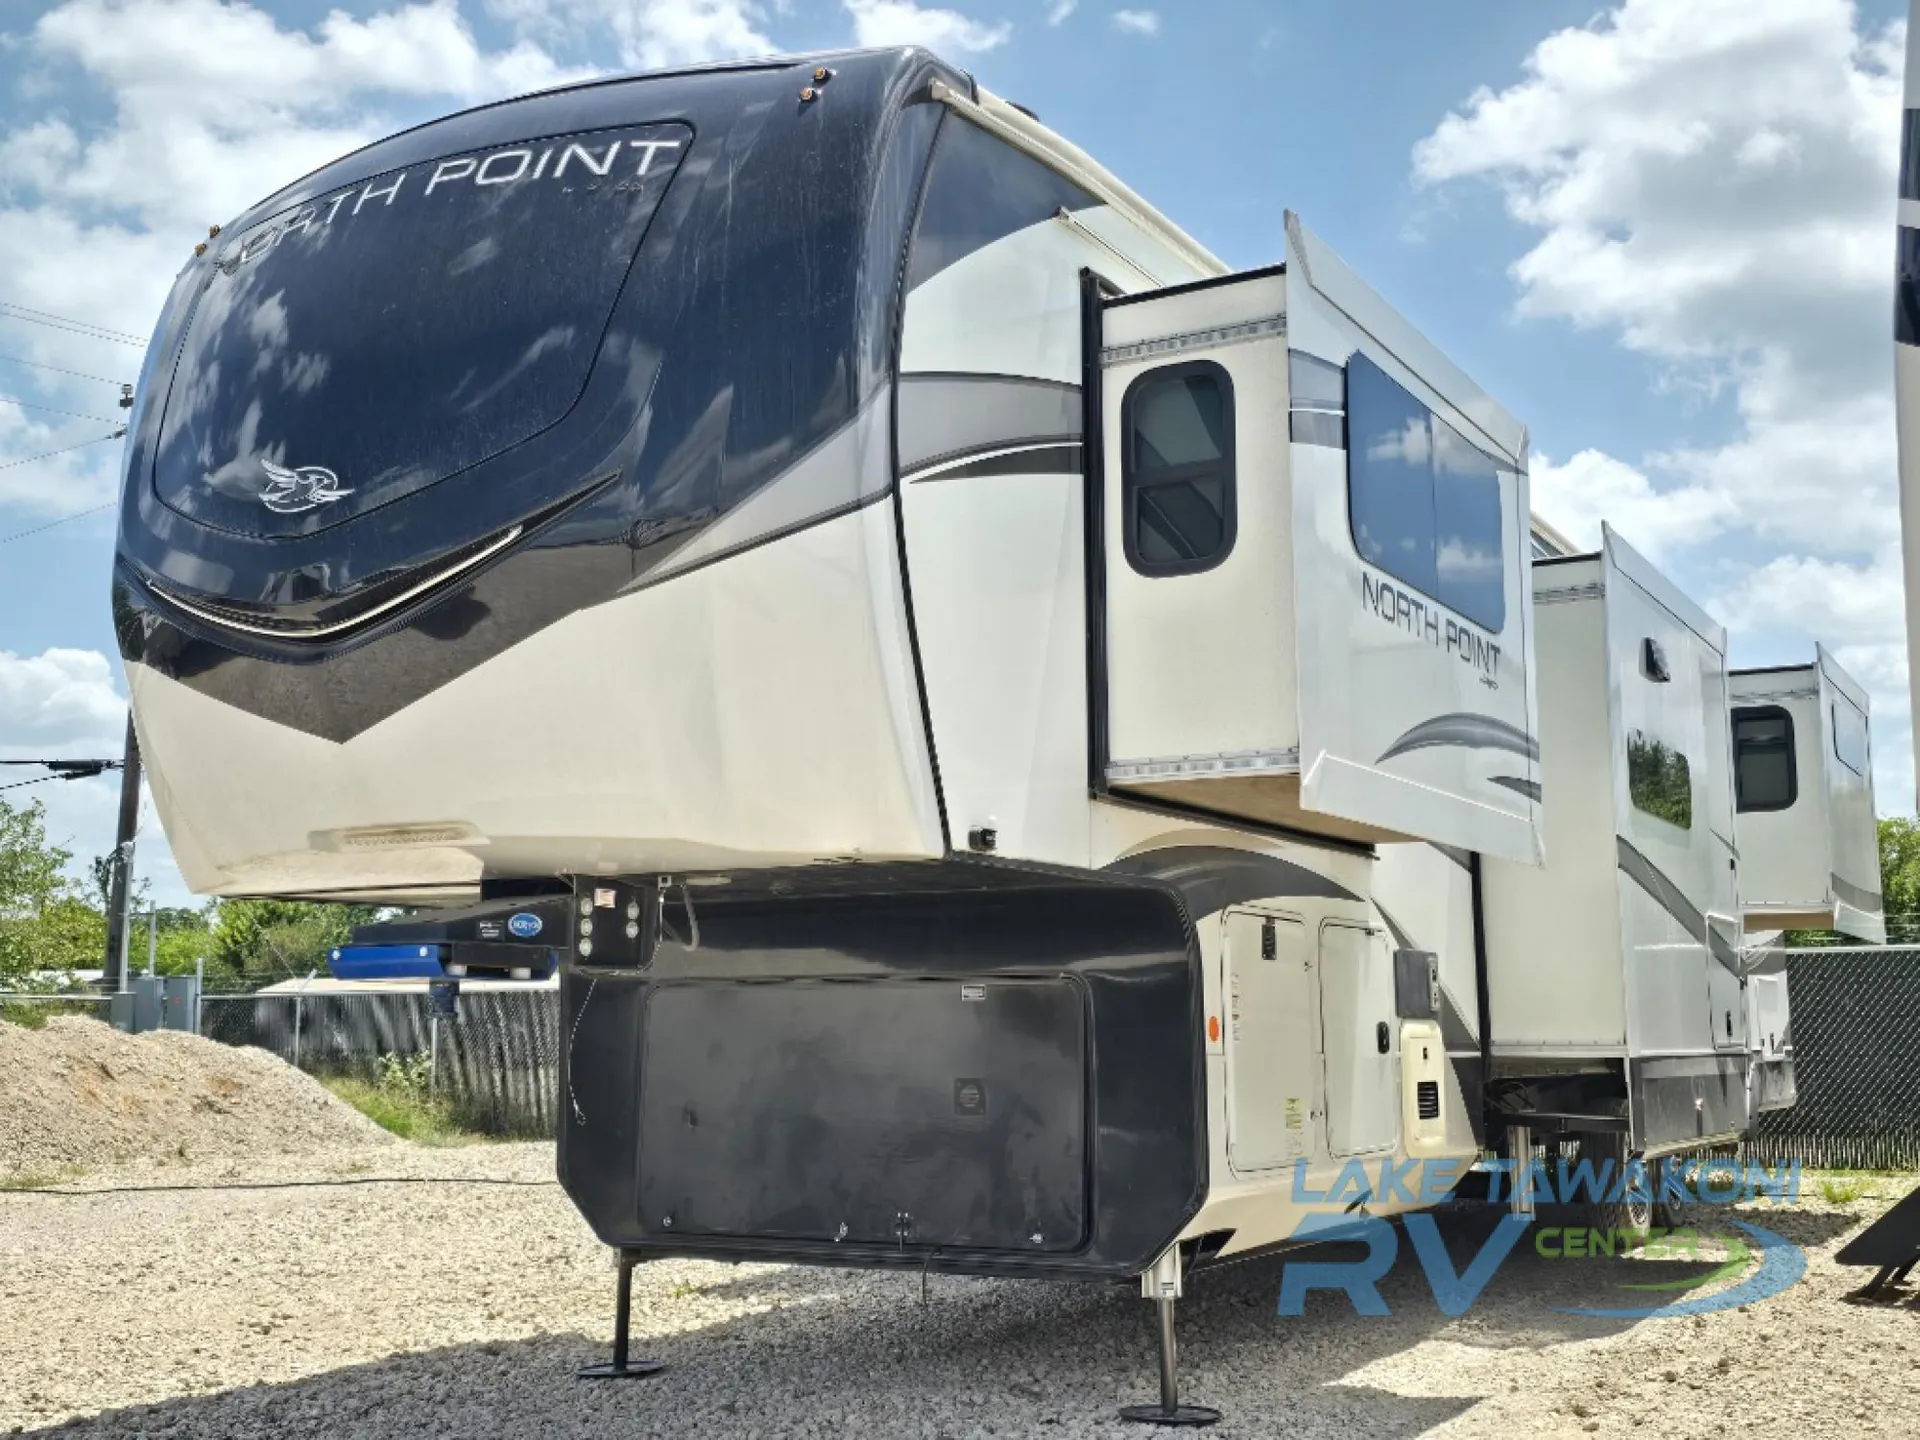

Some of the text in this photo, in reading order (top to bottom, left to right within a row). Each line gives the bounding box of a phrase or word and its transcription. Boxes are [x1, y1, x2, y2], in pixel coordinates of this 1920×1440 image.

[425, 140, 680, 195] POINT
[1362, 571, 1501, 676] NORTH POINT
